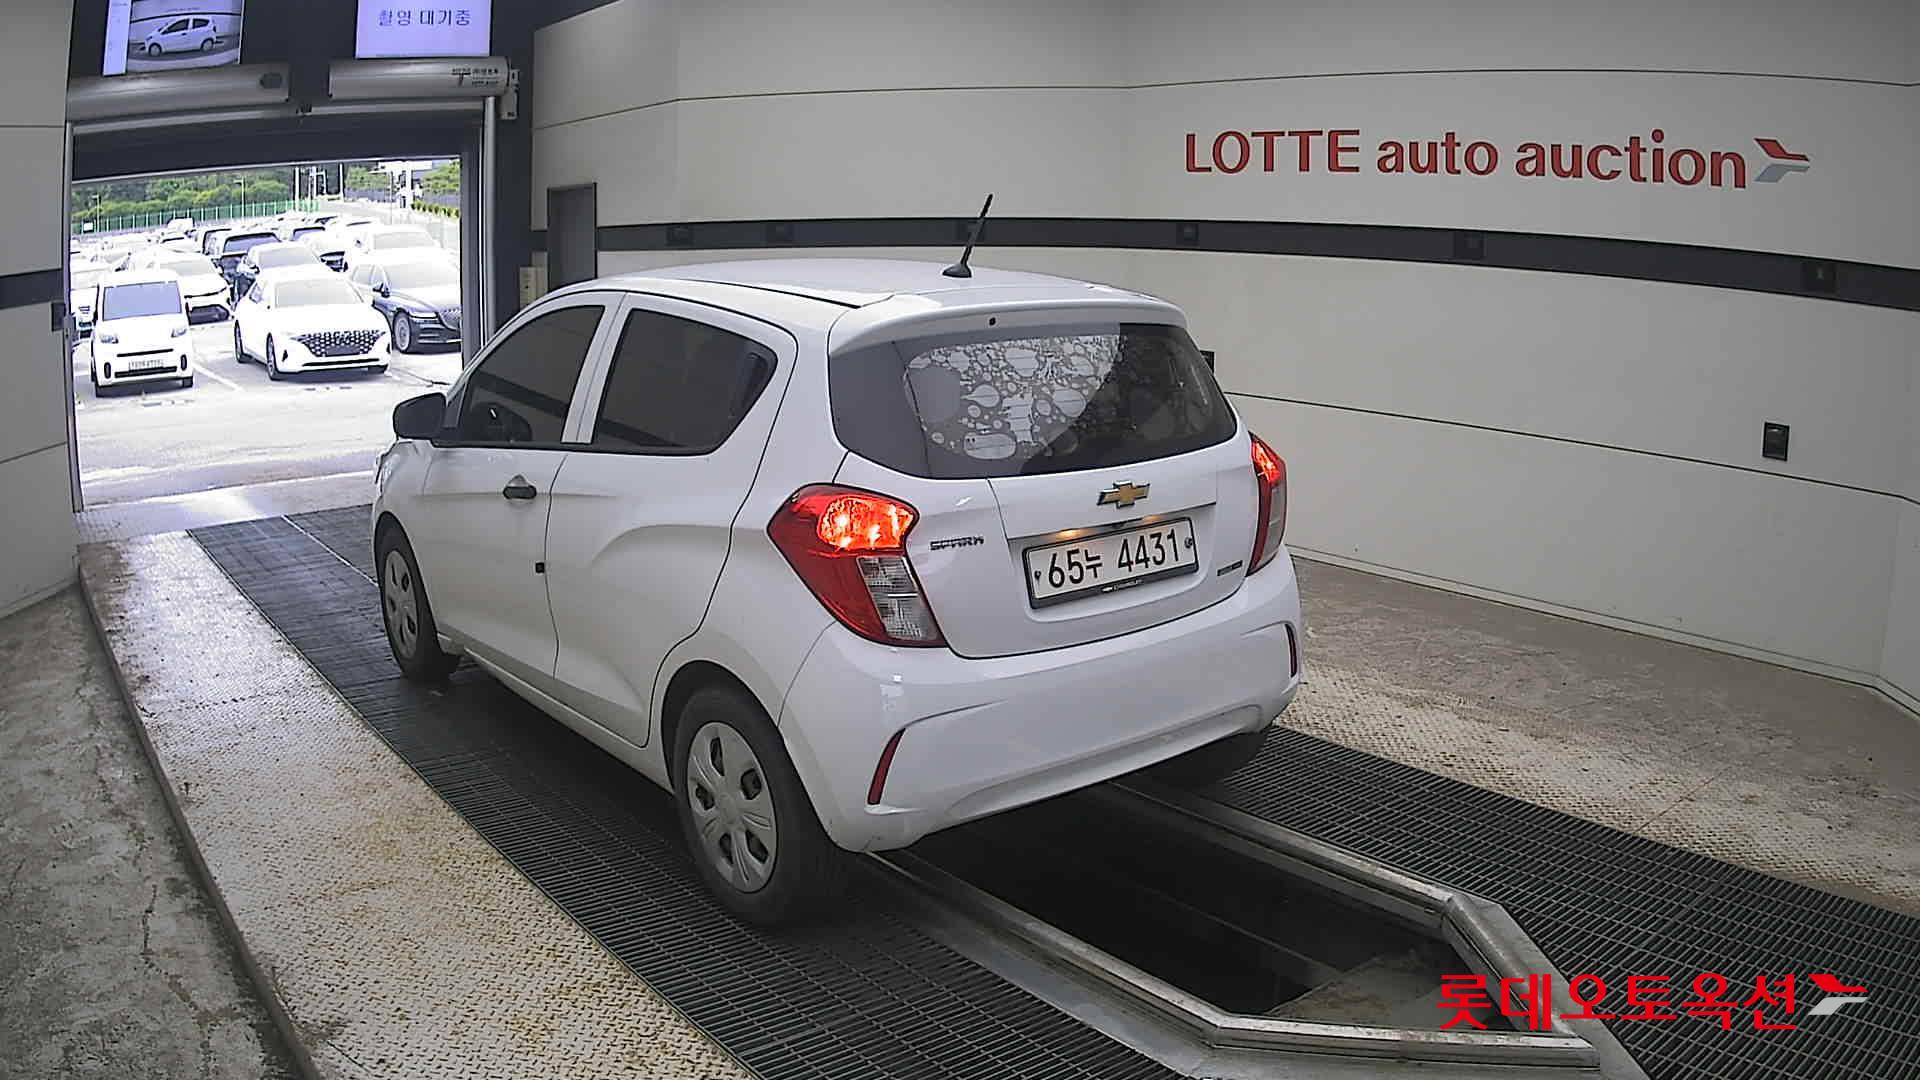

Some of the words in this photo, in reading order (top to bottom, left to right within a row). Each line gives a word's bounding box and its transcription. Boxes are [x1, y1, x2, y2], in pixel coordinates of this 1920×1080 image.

[419, 9, 470, 26] 대기중
[1185, 129, 1361, 174] LOTTE
[1377, 131, 1499, 177] auto
[1515, 129, 1747, 189] auction
[1048, 548, 1103, 588] 65누
[1117, 528, 1180, 573] 4431
